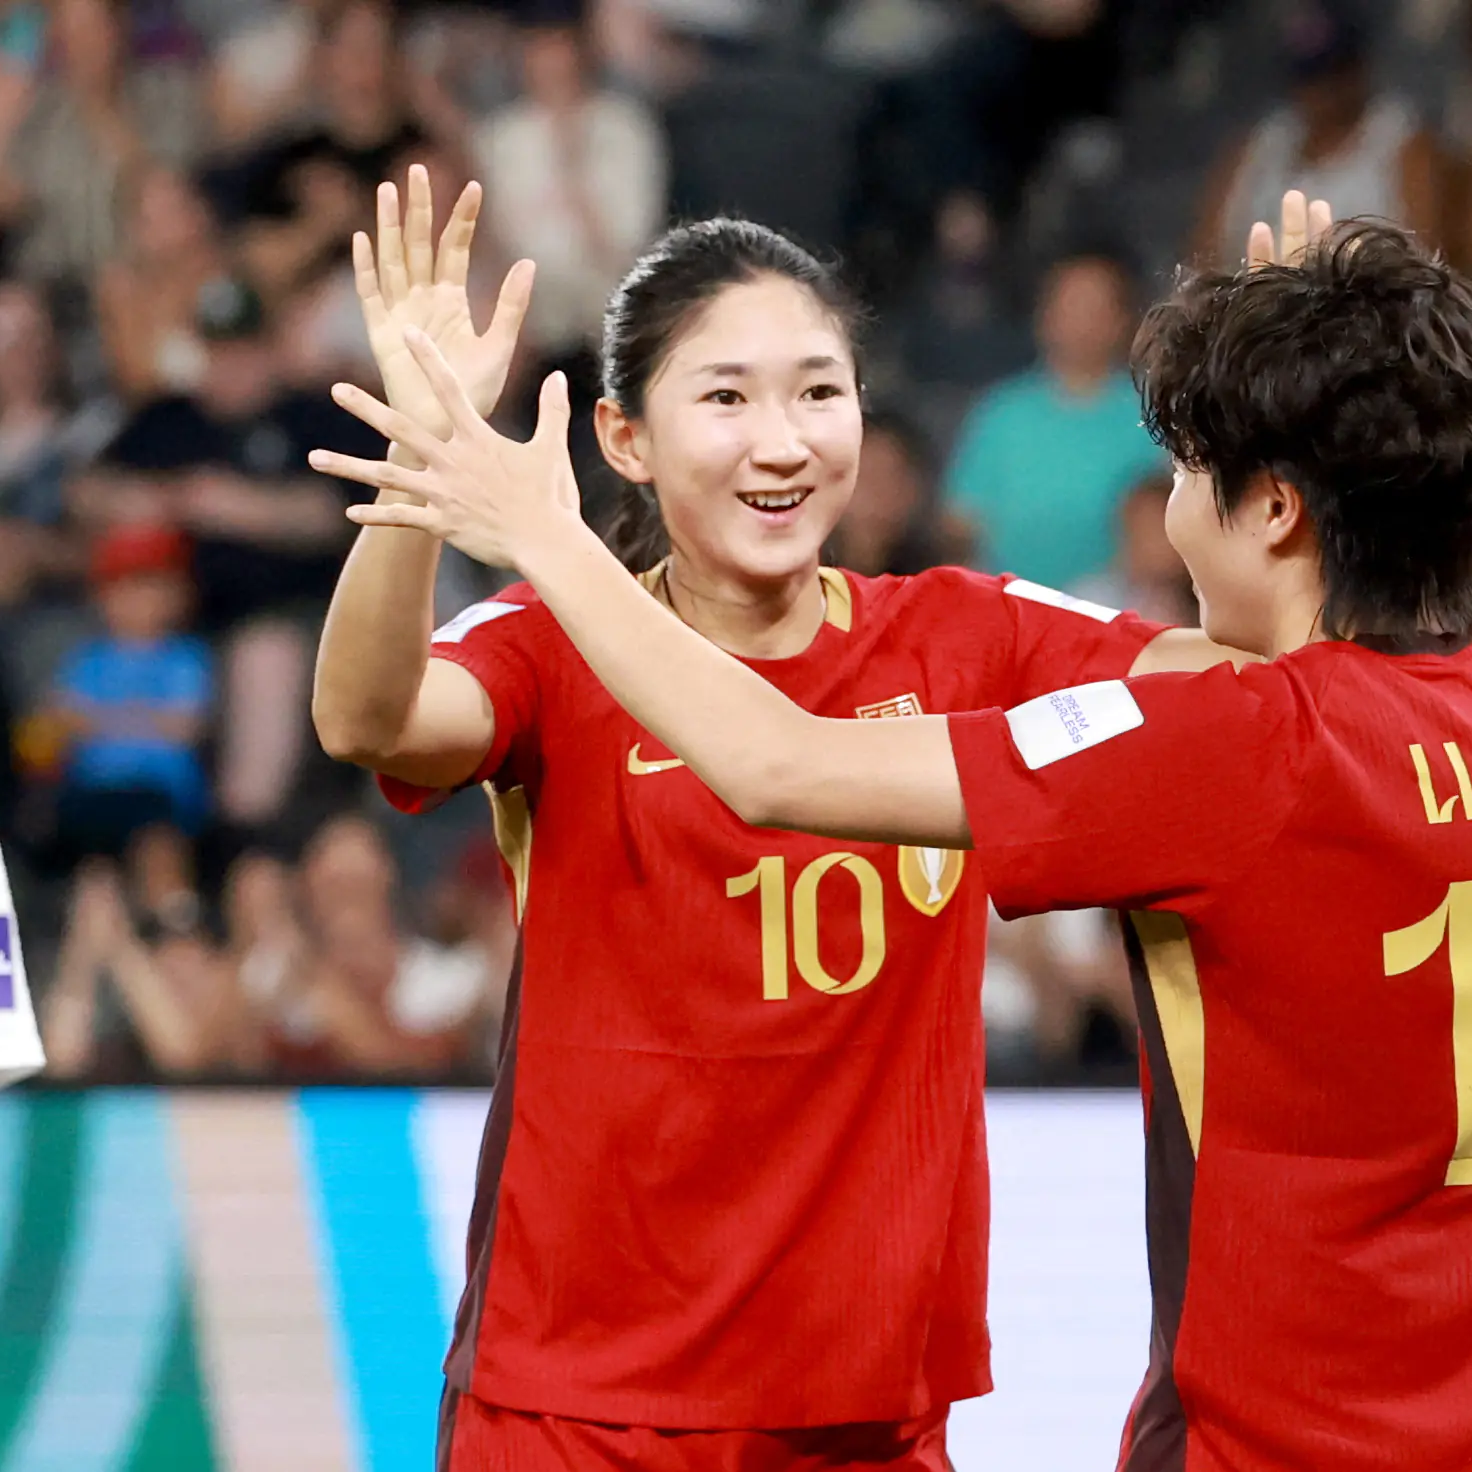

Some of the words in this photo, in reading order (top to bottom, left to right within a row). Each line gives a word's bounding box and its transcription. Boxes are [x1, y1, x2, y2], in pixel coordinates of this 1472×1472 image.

[1048, 694, 1084, 745] FEARLESS
[1062, 694, 1091, 731] DREAM
[726, 852, 886, 1001] 10
